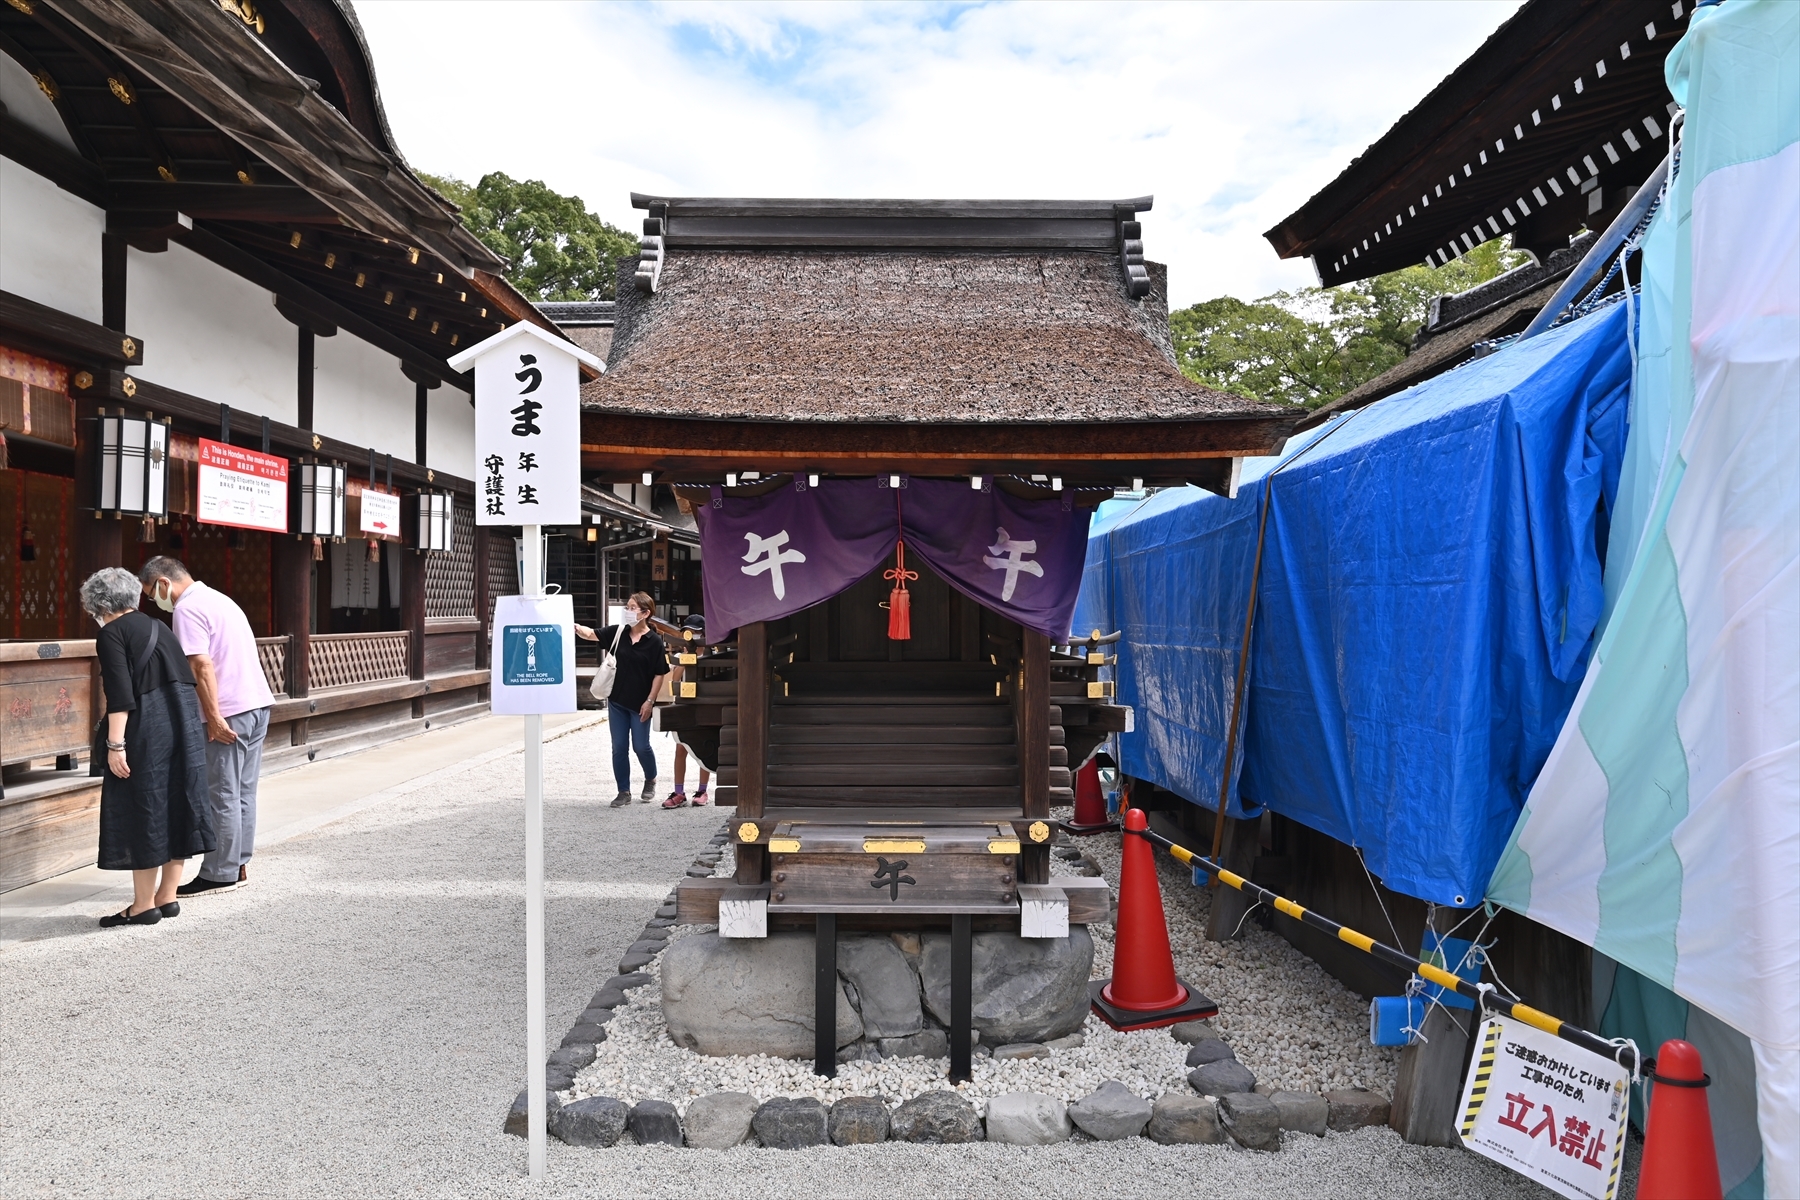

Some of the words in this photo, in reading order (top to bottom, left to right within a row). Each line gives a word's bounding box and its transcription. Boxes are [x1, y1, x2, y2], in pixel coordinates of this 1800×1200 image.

[211, 445, 222, 455] This
[246, 454, 254, 462] the
[254, 456, 265, 465] main
[219, 472, 236, 482] Praying
[236, 475, 255, 486] Etiquette
[260, 479, 271, 488] Kami
[484, 454, 506, 516] 守護社
[740, 529, 807, 601] 午
[983, 526, 1044, 602] 午
[870, 856, 917, 902] 午
[1504, 1041, 1612, 1093] ご迷惑おかけしています
[1520, 1066, 1586, 1103] 工事中のため、
[1497, 1092, 1606, 1171] 立入禁止
